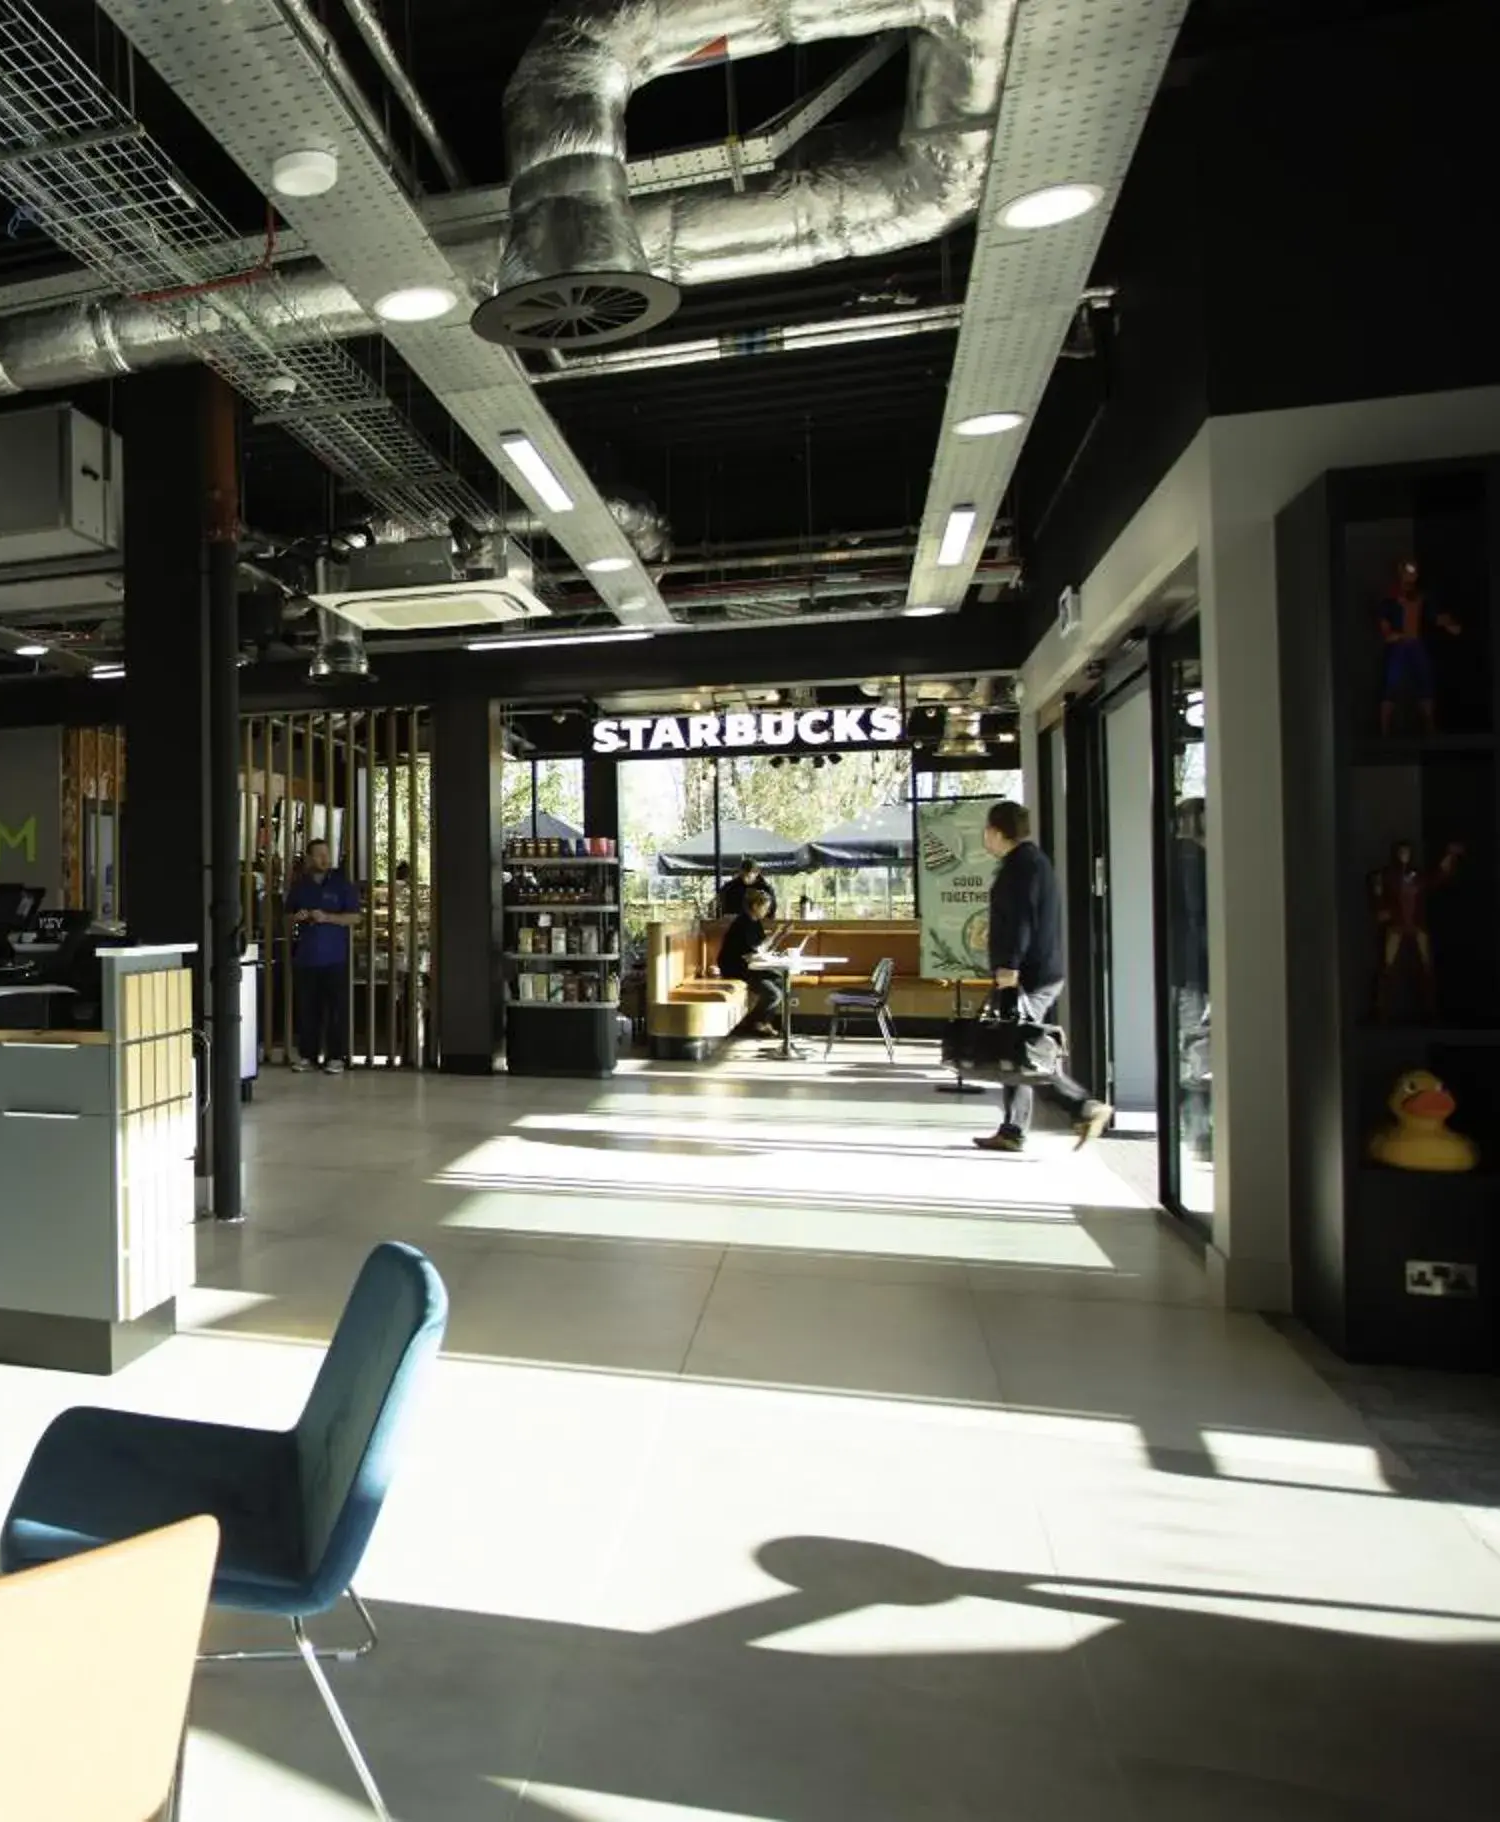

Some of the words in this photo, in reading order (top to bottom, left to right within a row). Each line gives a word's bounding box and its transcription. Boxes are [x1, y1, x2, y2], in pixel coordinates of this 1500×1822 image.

[592, 706, 902, 753] STARBUCKS
[953, 876, 983, 887] GOOD
[941, 891, 990, 903] TOGETHE
